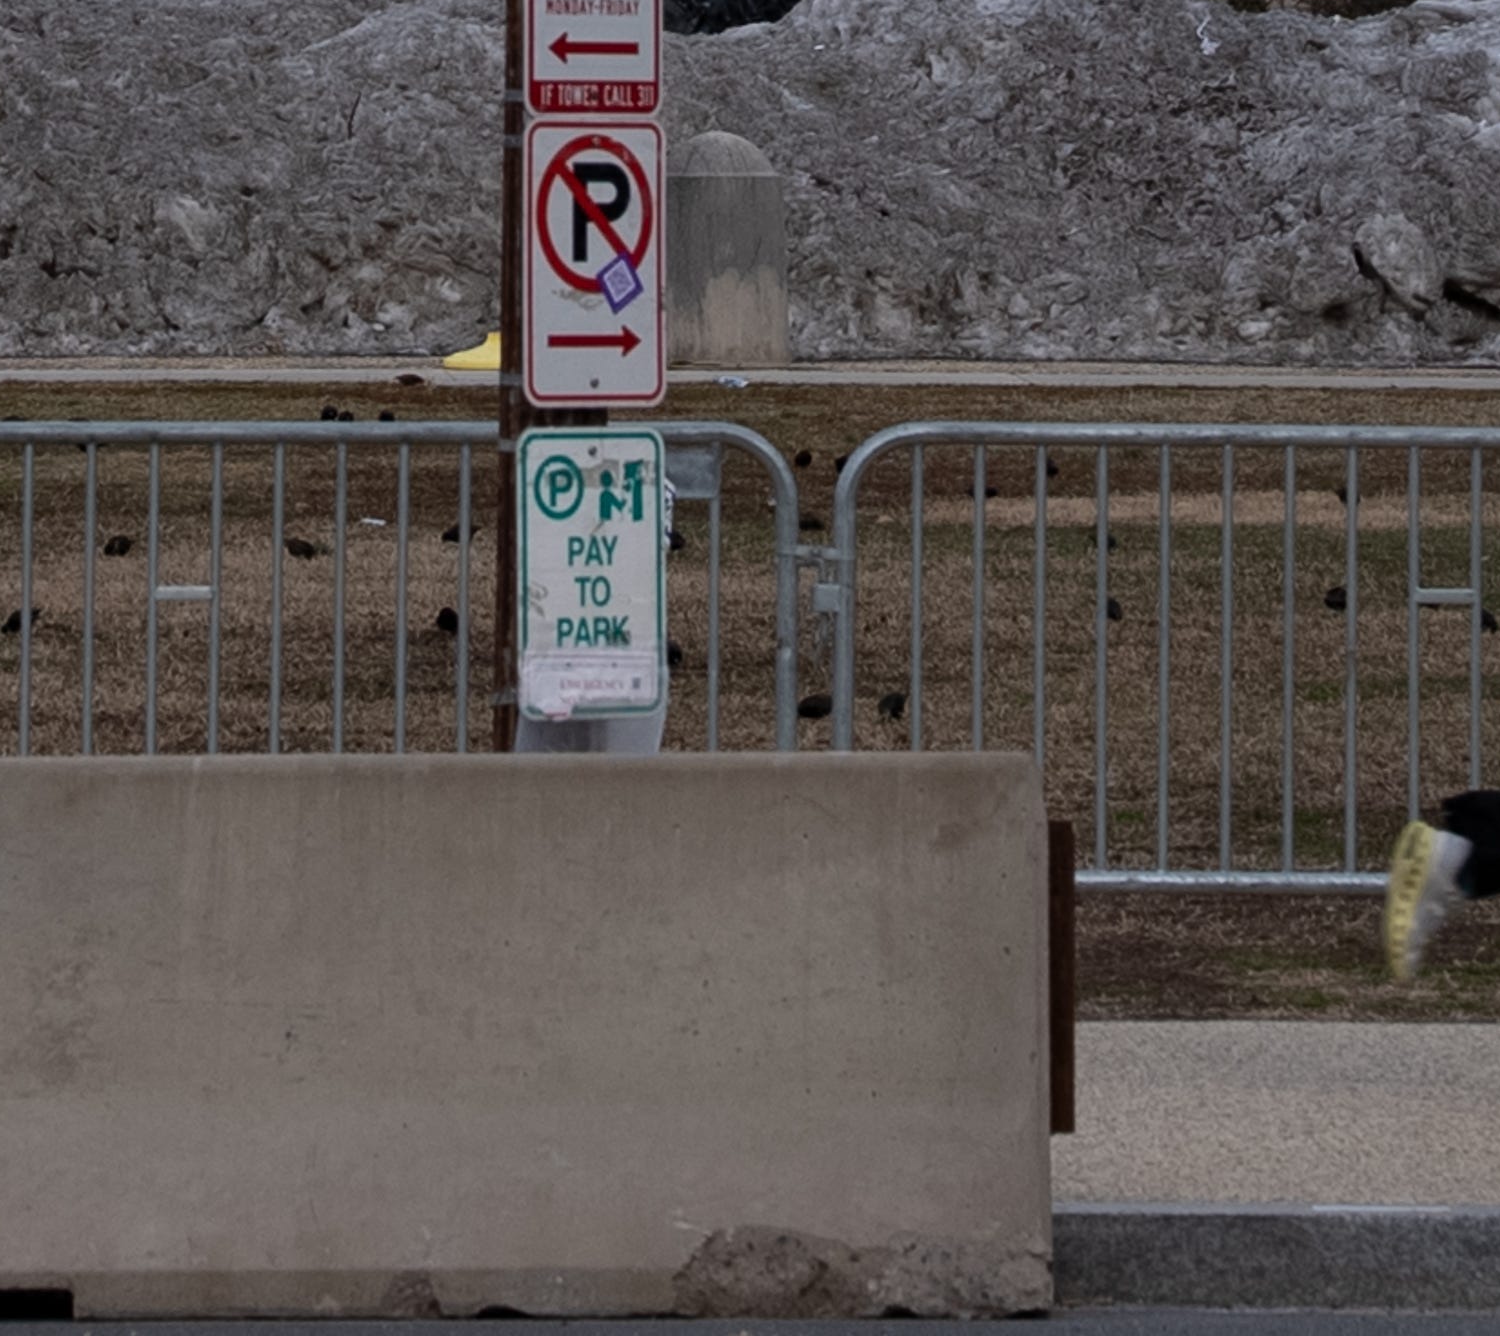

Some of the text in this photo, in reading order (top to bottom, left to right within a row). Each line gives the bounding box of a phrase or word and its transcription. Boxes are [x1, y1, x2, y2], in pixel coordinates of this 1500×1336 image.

[545, 0, 640, 16] MONDAY-FRIDAY
[540, 84, 655, 107] IF TOWED CALL 311
[567, 535, 618, 566] PAY
[574, 575, 612, 607] TO
[556, 615, 631, 648] PARK
